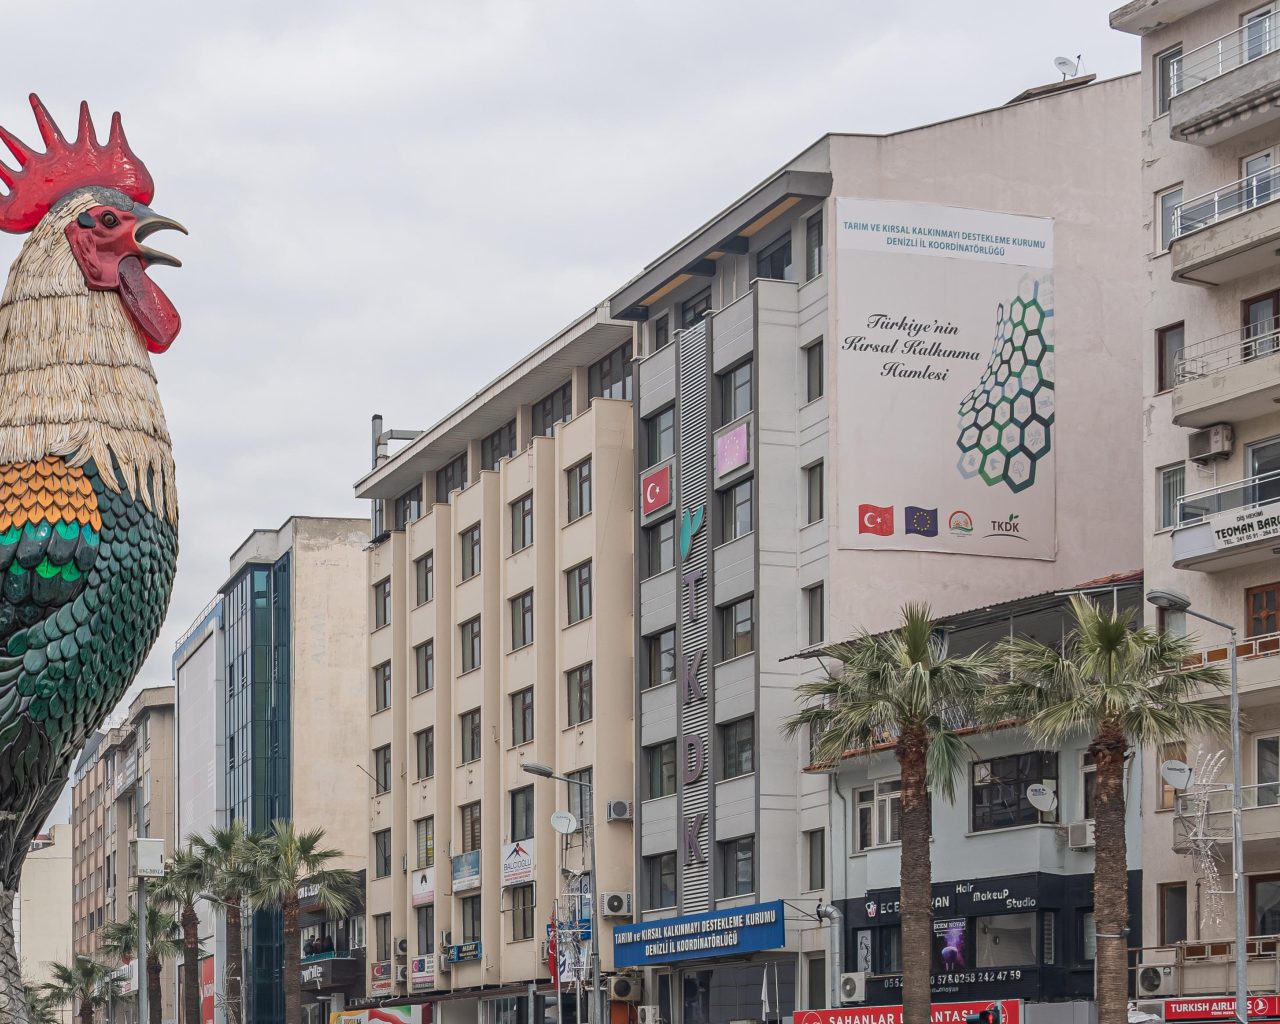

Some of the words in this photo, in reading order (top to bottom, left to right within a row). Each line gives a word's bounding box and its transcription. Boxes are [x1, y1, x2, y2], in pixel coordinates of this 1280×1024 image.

[844, 221, 869, 231] TARIM
[870, 224, 881, 232] VE
[882, 225, 910, 235] KIRSAL
[912, 227, 960, 240] KALKINMAYI
[962, 232, 1011, 245] DESTEKLEME
[1012, 237, 1046, 249] KURUMU
[886, 237, 918, 247] DENİZLİ
[920, 238, 927, 248] İL
[928, 239, 1005, 256] KOORDİNATÖRLÜĞÜ
[866, 313, 960, 338] Türkiye'nin
[841, 335, 900, 354] Kırsal
[901, 339, 981, 361] Kalkınma
[880, 361, 950, 382] Hamlesi
[991, 520, 1019, 532] TKDK
[1215, 522, 1254, 540] TEOMAN
[956, 882, 974, 894] Hair
[1006, 897, 1037, 908] Studio
[880, 902, 901, 914] ECE
[615, 932, 633, 944] TARIM
[634, 934, 641, 942] ve
[641, 929, 662, 941] KIRSAL
[664, 923, 700, 938] KALKINMAYI
[702, 916, 744, 932] DESTEKLEME
[745, 910, 776, 925] KURUMU
[645, 941, 668, 956] DENİZLİ
[669, 940, 676, 953] İL
[676, 930, 738, 951] KOORDİNATÖRLÜĞÜ
[978, 972, 995, 982] 242
[997, 971, 1007, 981] 47
[1010, 970, 1021, 980] 59
[1171, 1003, 1209, 1013] TURKISH
[1211, 1001, 1253, 1010] AIRLIS
